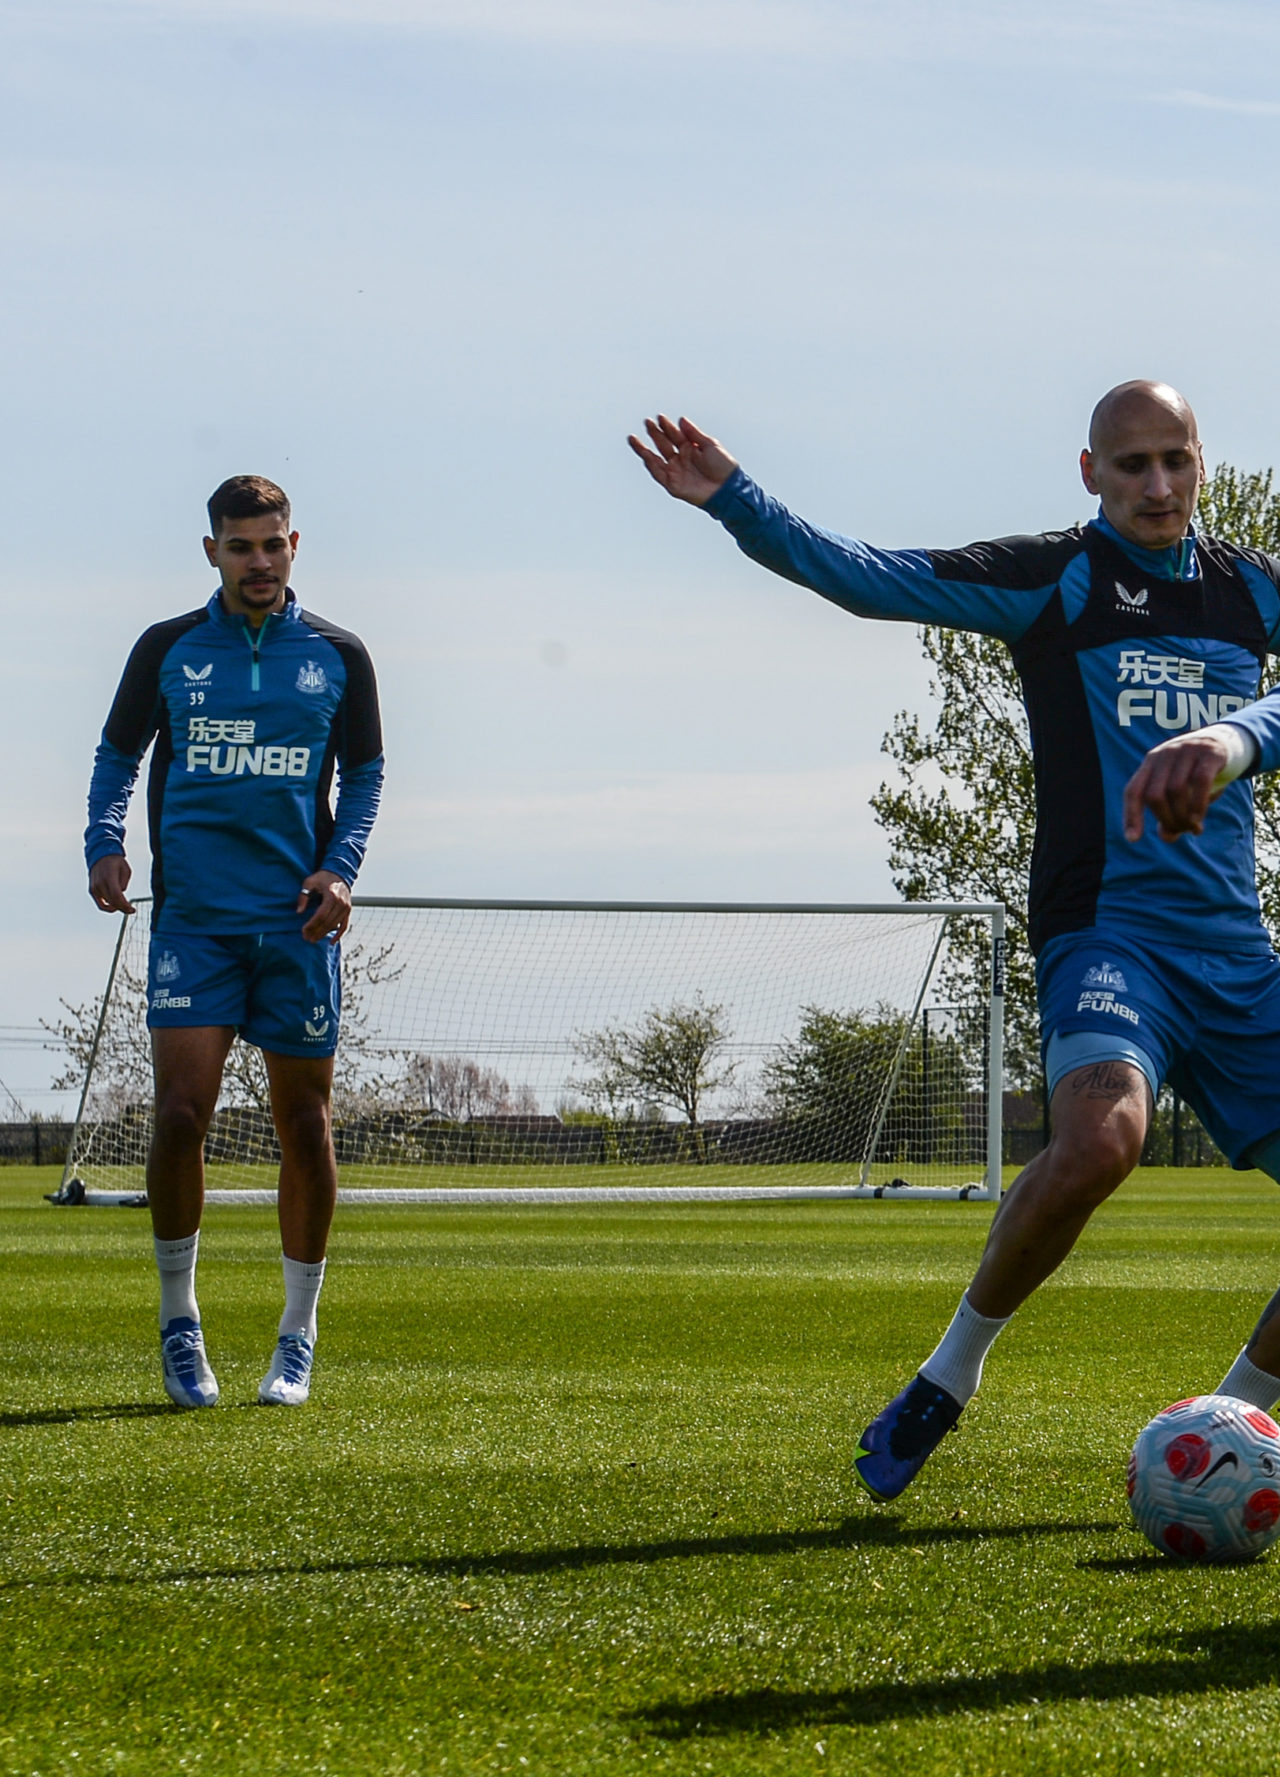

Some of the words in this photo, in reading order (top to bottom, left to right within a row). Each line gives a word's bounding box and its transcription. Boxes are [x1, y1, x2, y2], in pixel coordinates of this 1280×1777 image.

[1115, 603, 1150, 616] CASTORE
[190, 691, 205, 706] 39
[1117, 689, 1255, 730] FUN8
[187, 716, 256, 744] 乐天堂
[186, 745, 310, 777] FUN88
[151, 996, 191, 1010] FUN88
[313, 1005, 326, 1020] 39
[1076, 1000, 1140, 1025] FUN88
